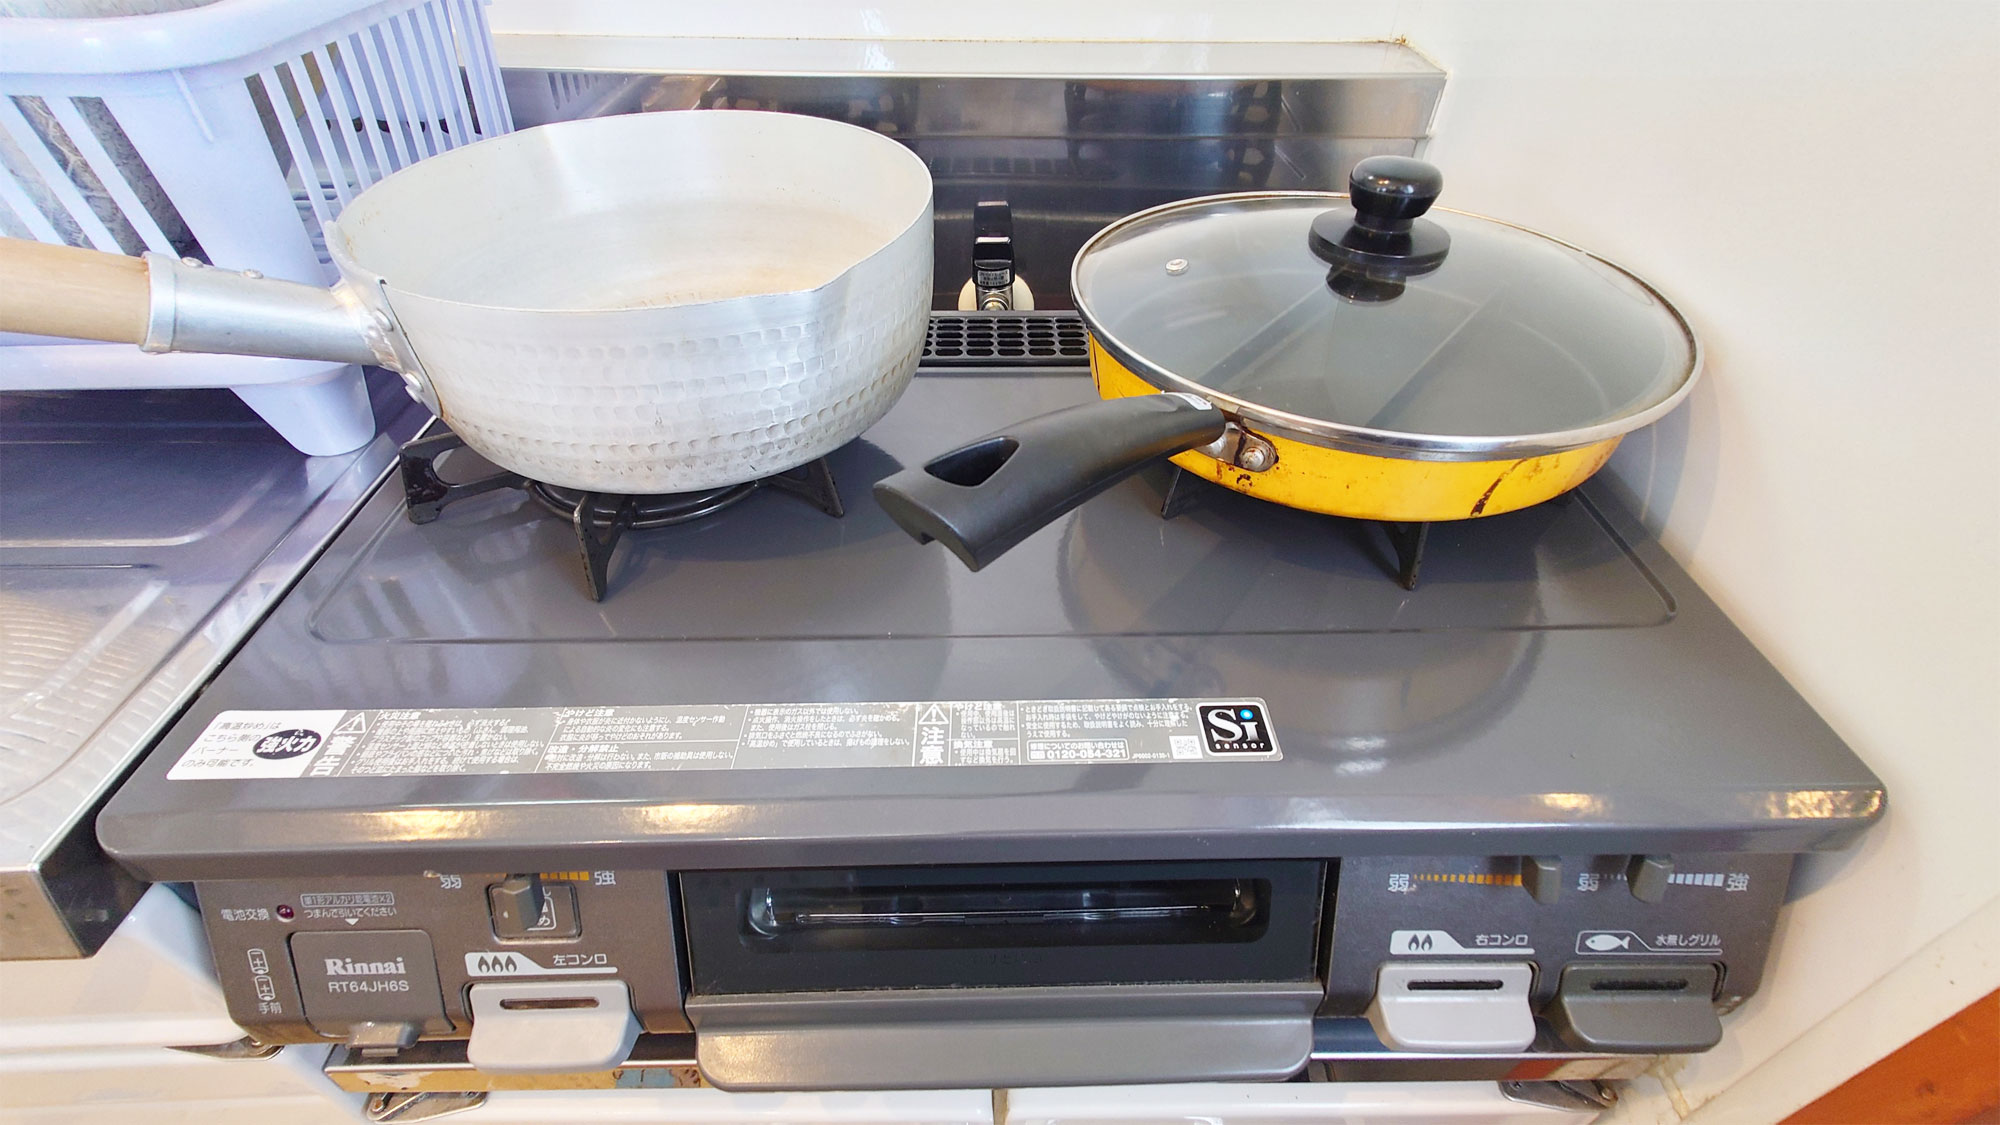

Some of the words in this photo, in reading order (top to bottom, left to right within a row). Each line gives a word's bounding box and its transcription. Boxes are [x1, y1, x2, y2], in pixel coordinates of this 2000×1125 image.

[1207, 708, 1259, 742] Si
[256, 736, 317, 753] 強火力
[1215, 742, 1265, 750] sensor
[1387, 873, 1410, 893] 弱
[1577, 873, 1600, 891] 弱
[1726, 873, 1750, 892] 強
[221, 908, 270, 922] 電池交換
[1475, 934, 1529, 946] 右コンロ
[1655, 934, 1722, 947] 水無しグリル
[324, 957, 406, 976] Rinnai
[553, 953, 608, 966] 左コンロ
[328, 980, 410, 993] RT64JH6S
[259, 1002, 282, 1015] 手前
